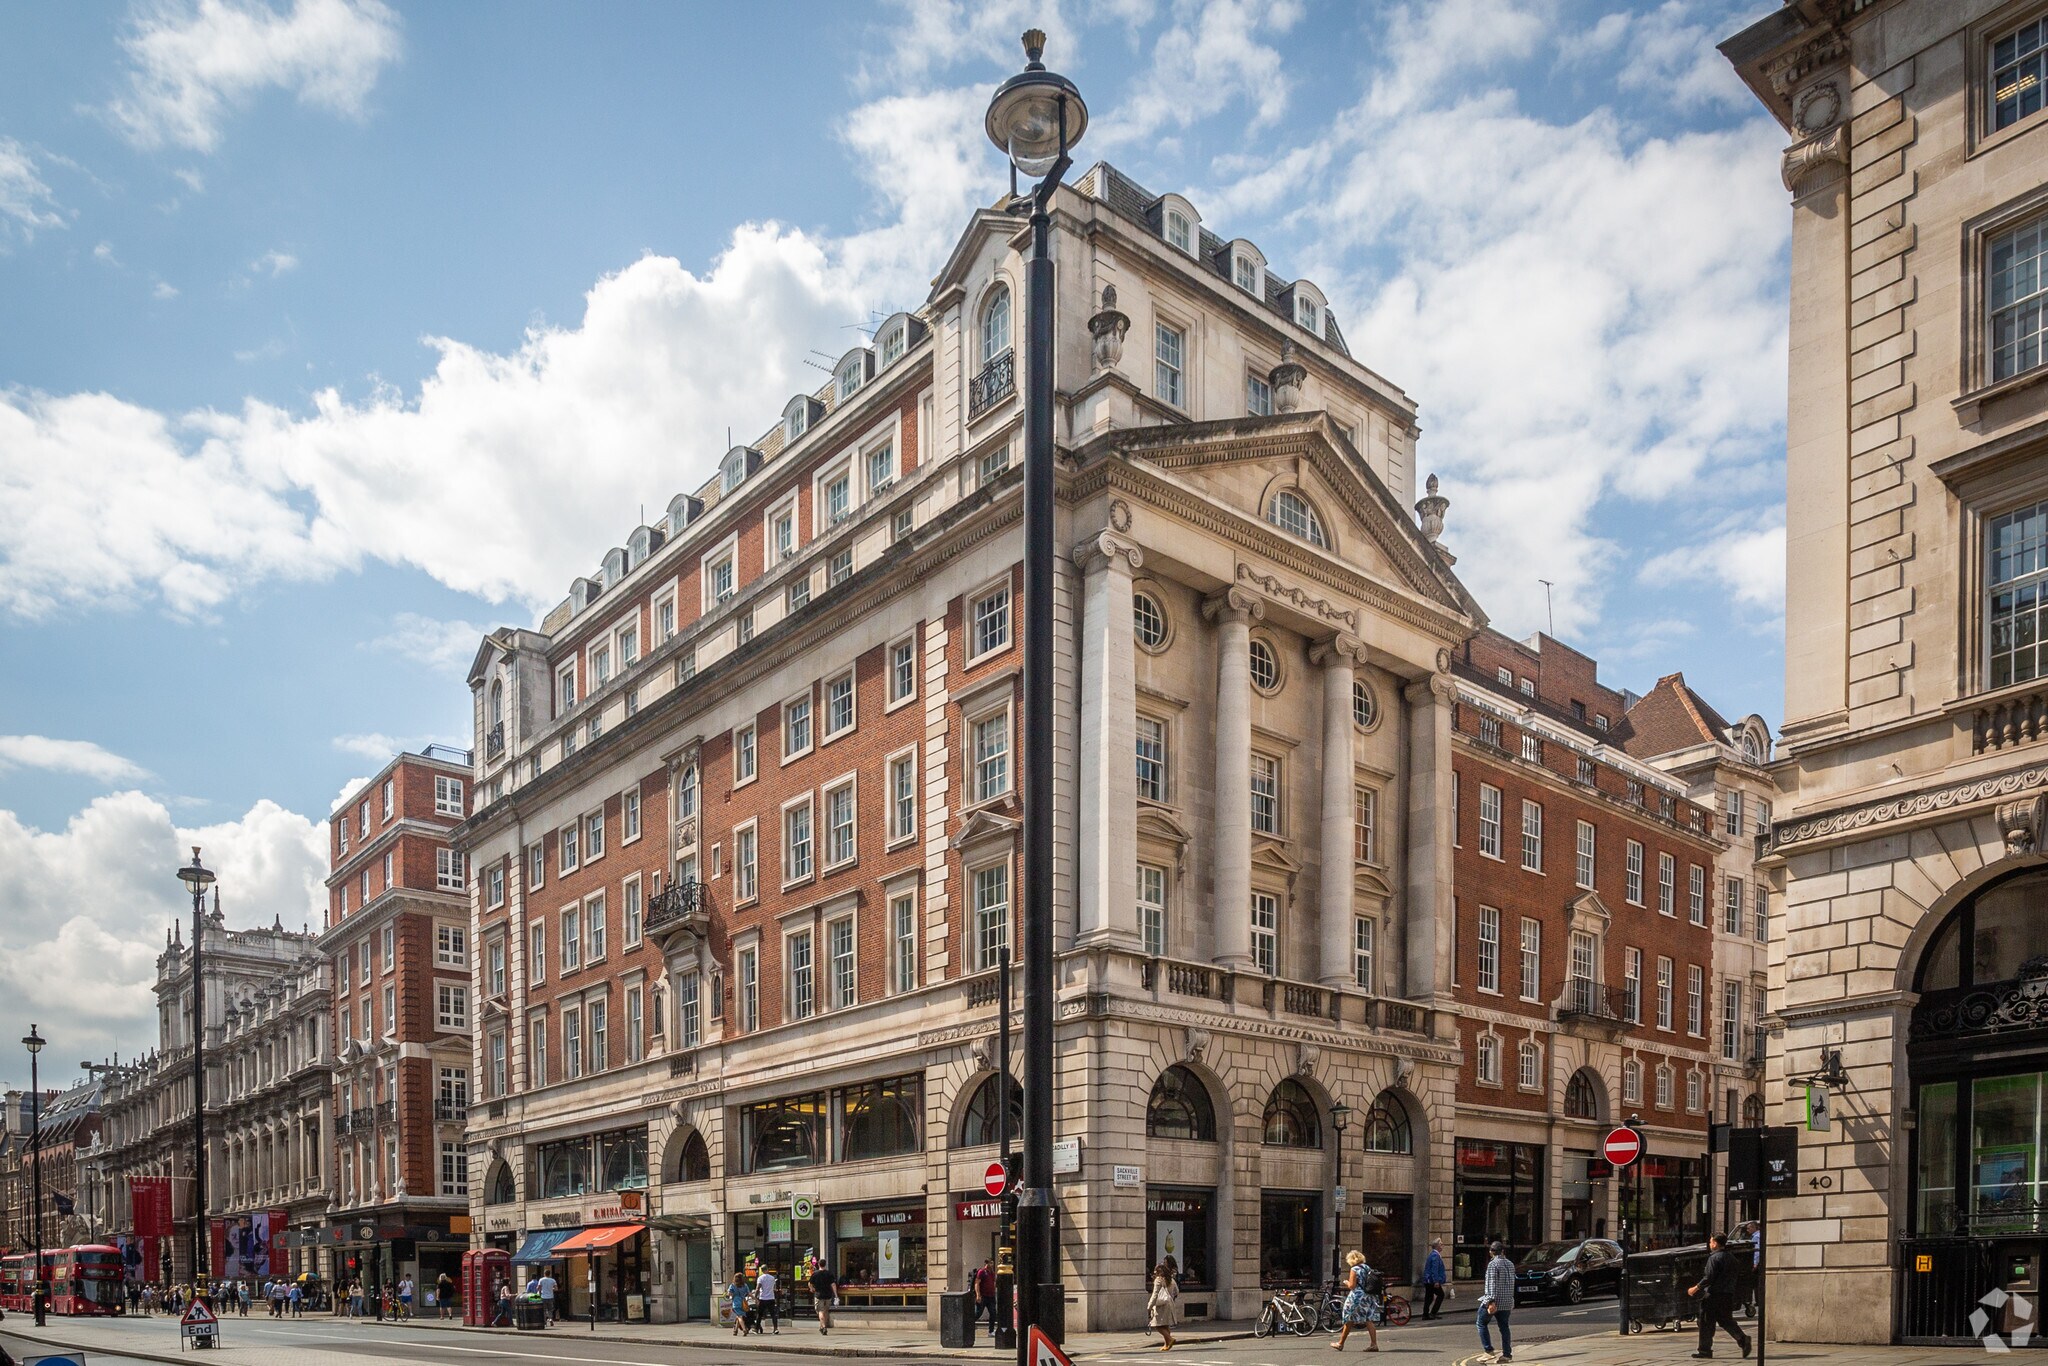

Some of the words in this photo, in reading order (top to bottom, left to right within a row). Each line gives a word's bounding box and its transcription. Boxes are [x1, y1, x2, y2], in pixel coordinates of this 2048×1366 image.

[1053, 1143, 1069, 1151] ADILLY
[1116, 1167, 1138, 1175] SACKVILLE
[1809, 1175, 1832, 1190] 40
[970, 1204, 984, 1217] PRET
[986, 1203, 990, 1216] A
[1148, 1200, 1160, 1212] PRET
[1160, 1200, 1165, 1212] A
[1165, 1200, 1185, 1212] MANGER
[876, 1213, 886, 1225] PRET
[886, 1213, 890, 1224] A
[890, 1212, 906, 1224] MANGER
[1918, 1256, 1930, 1270] H
[188, 1324, 212, 1335] End
